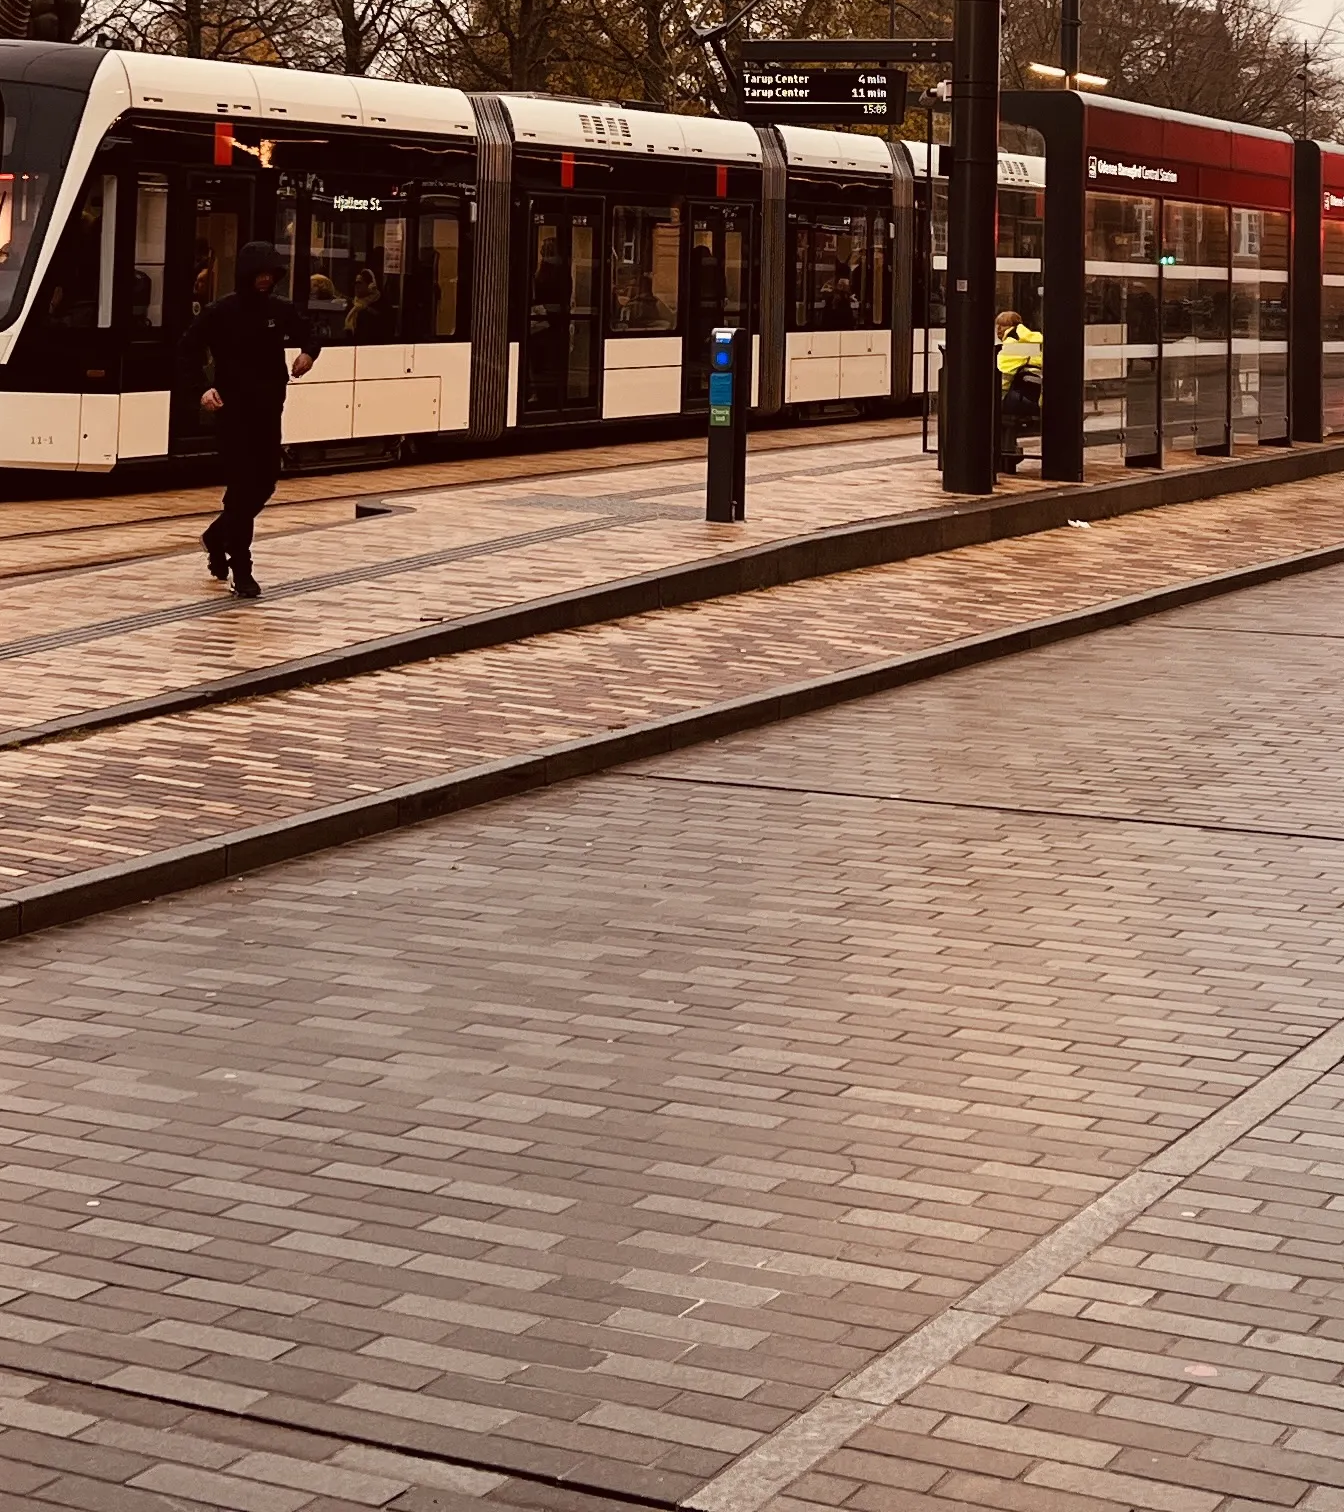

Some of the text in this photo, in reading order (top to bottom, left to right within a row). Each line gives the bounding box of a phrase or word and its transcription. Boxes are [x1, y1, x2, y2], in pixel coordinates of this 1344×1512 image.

[743, 74, 887, 85] Tarup Center 4 min
[743, 88, 887, 98] Tarup Center 11 min
[333, 195, 382, 211] Hjallese St.
